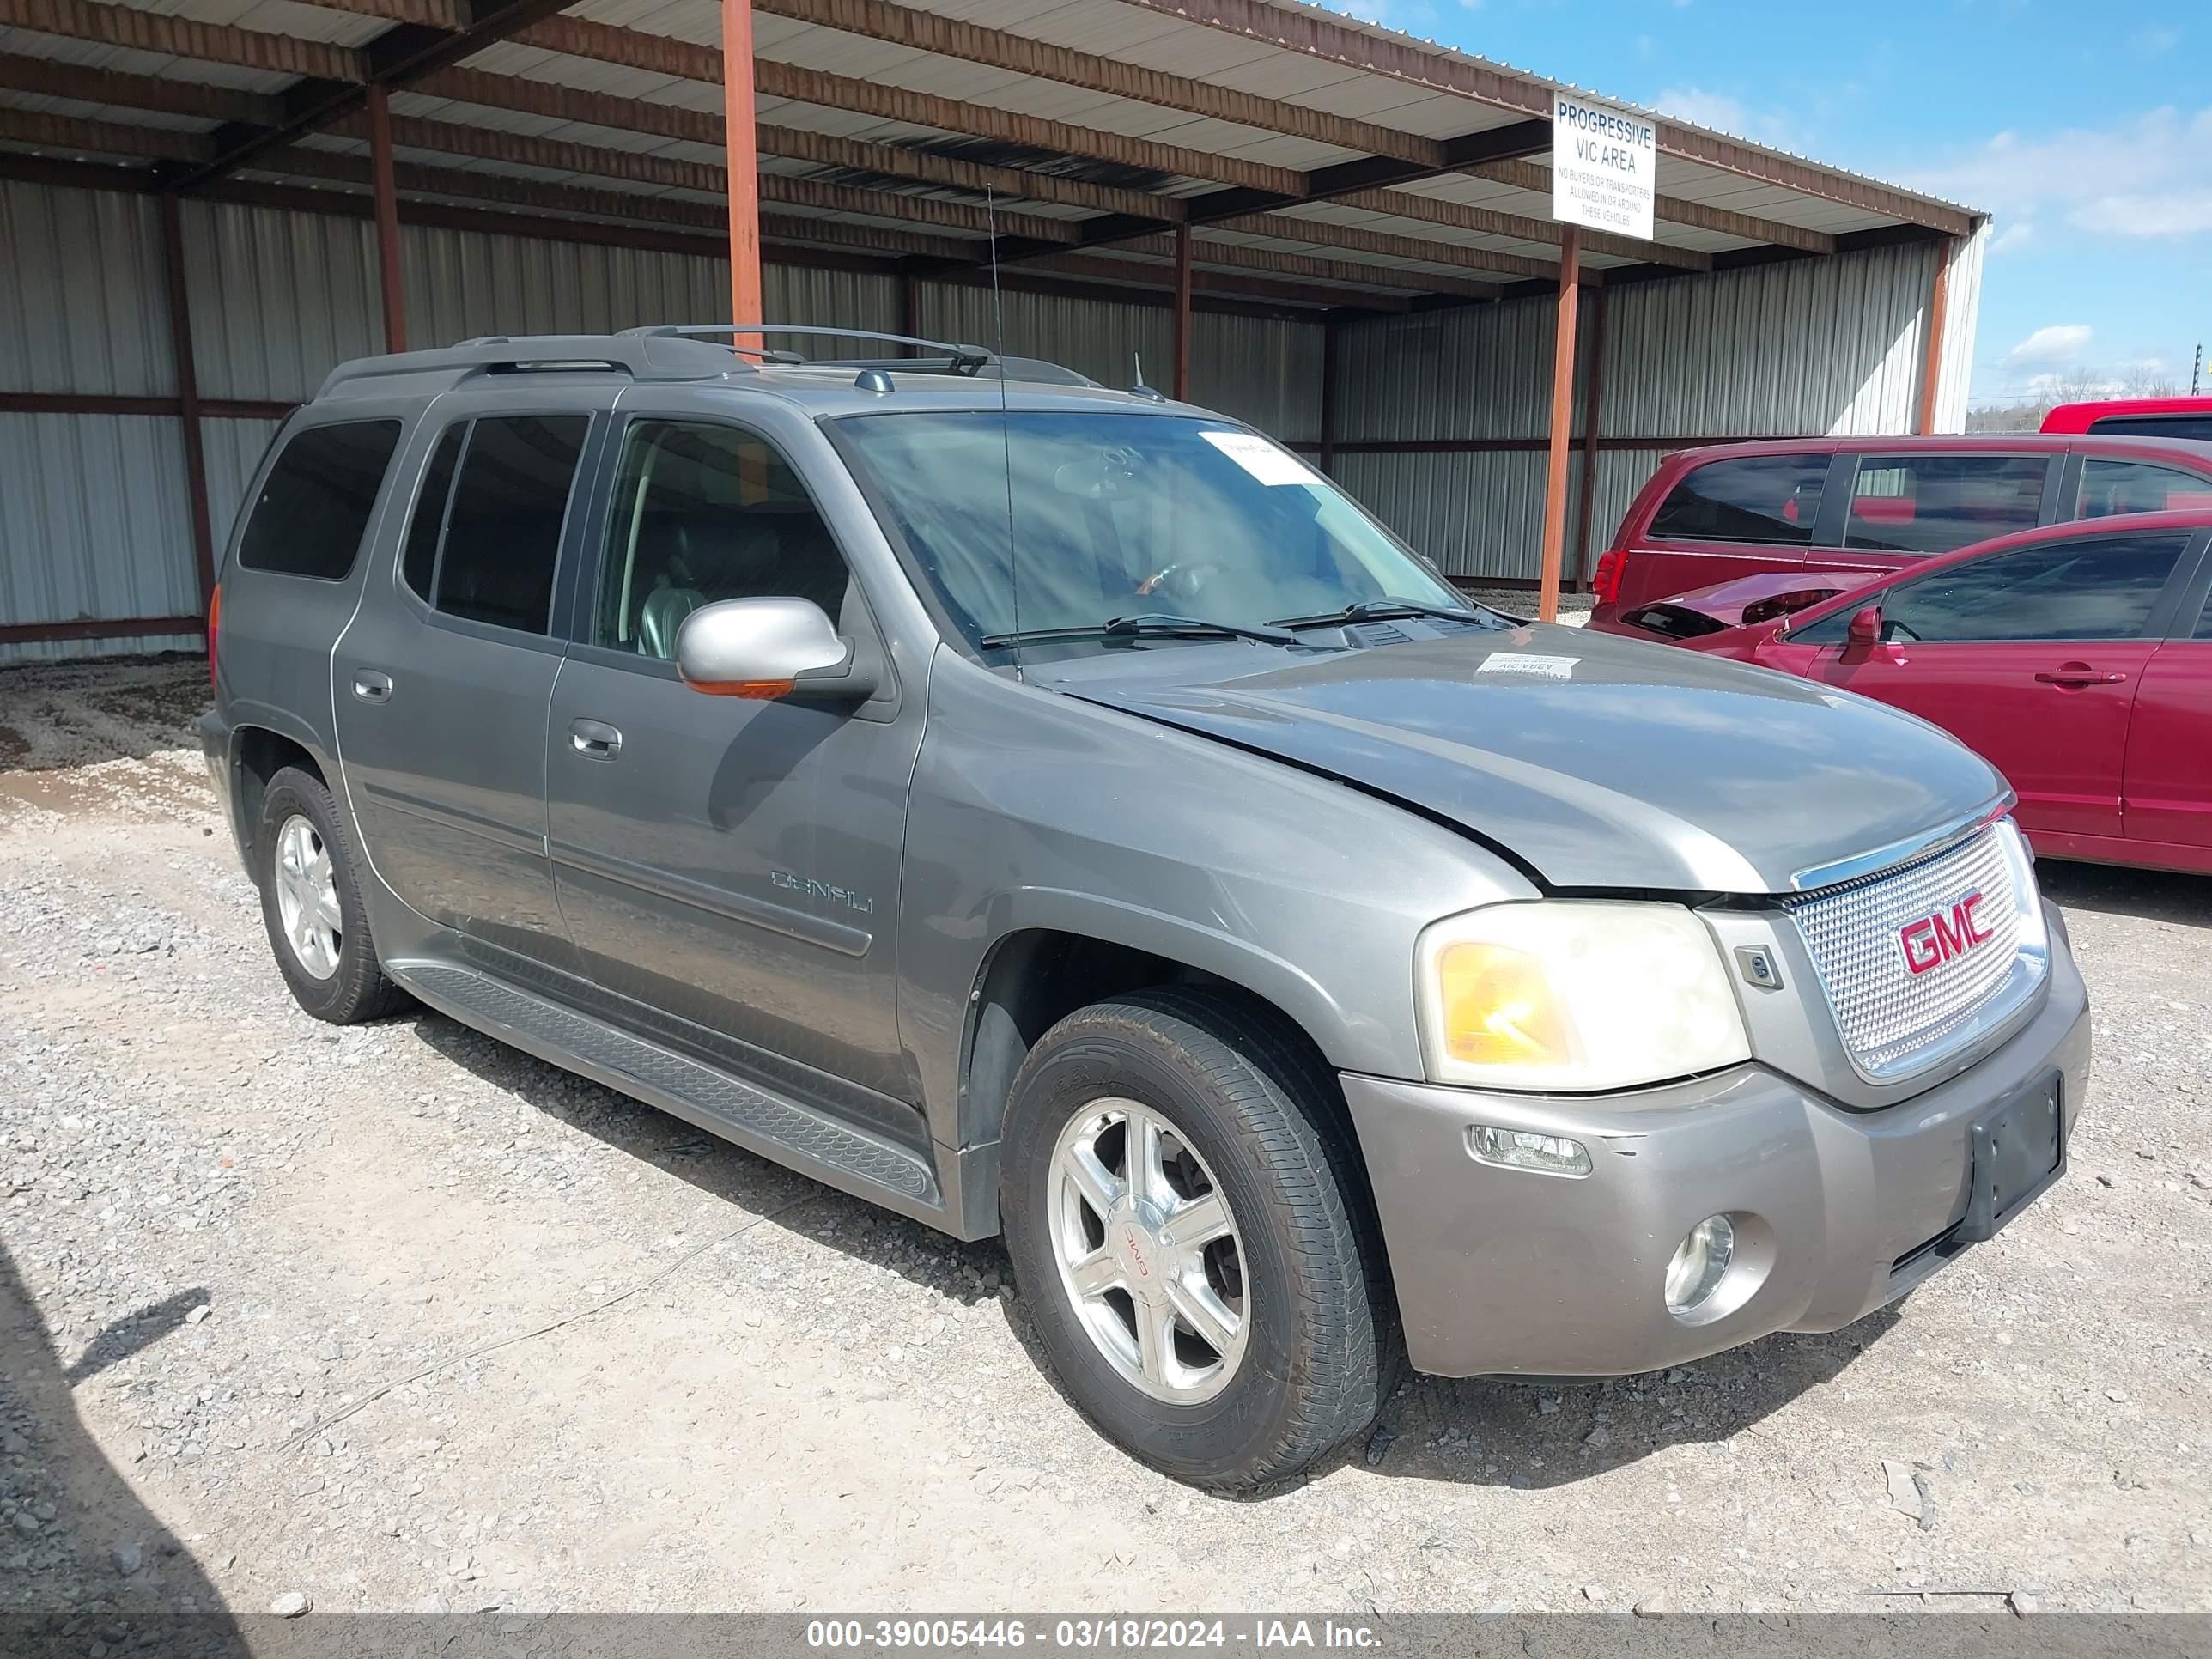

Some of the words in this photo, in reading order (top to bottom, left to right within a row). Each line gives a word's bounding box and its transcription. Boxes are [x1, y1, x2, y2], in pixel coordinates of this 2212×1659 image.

[1559, 101, 1651, 149] PROGRESSIVE
[1576, 137, 1598, 163] VIC
[1601, 145, 1637, 174] AREA
[1559, 167, 1568, 179] NO
[1569, 168, 1595, 185] BUYERS
[1595, 175, 1604, 188] OR
[1606, 179, 1650, 200] TRANSPORTERS
[1569, 185, 1600, 204] ALLOWED
[1601, 194, 1607, 205] IN
[1607, 195, 1617, 207] OR
[1618, 198, 1641, 214] AROUND
[1582, 204, 1601, 220] THESE
[1602, 210, 1631, 227] VEHICLES
[771, 870, 873, 915] DENALI
[1899, 891, 1995, 975] GMC
[1123, 1227, 1149, 1277] GMC
